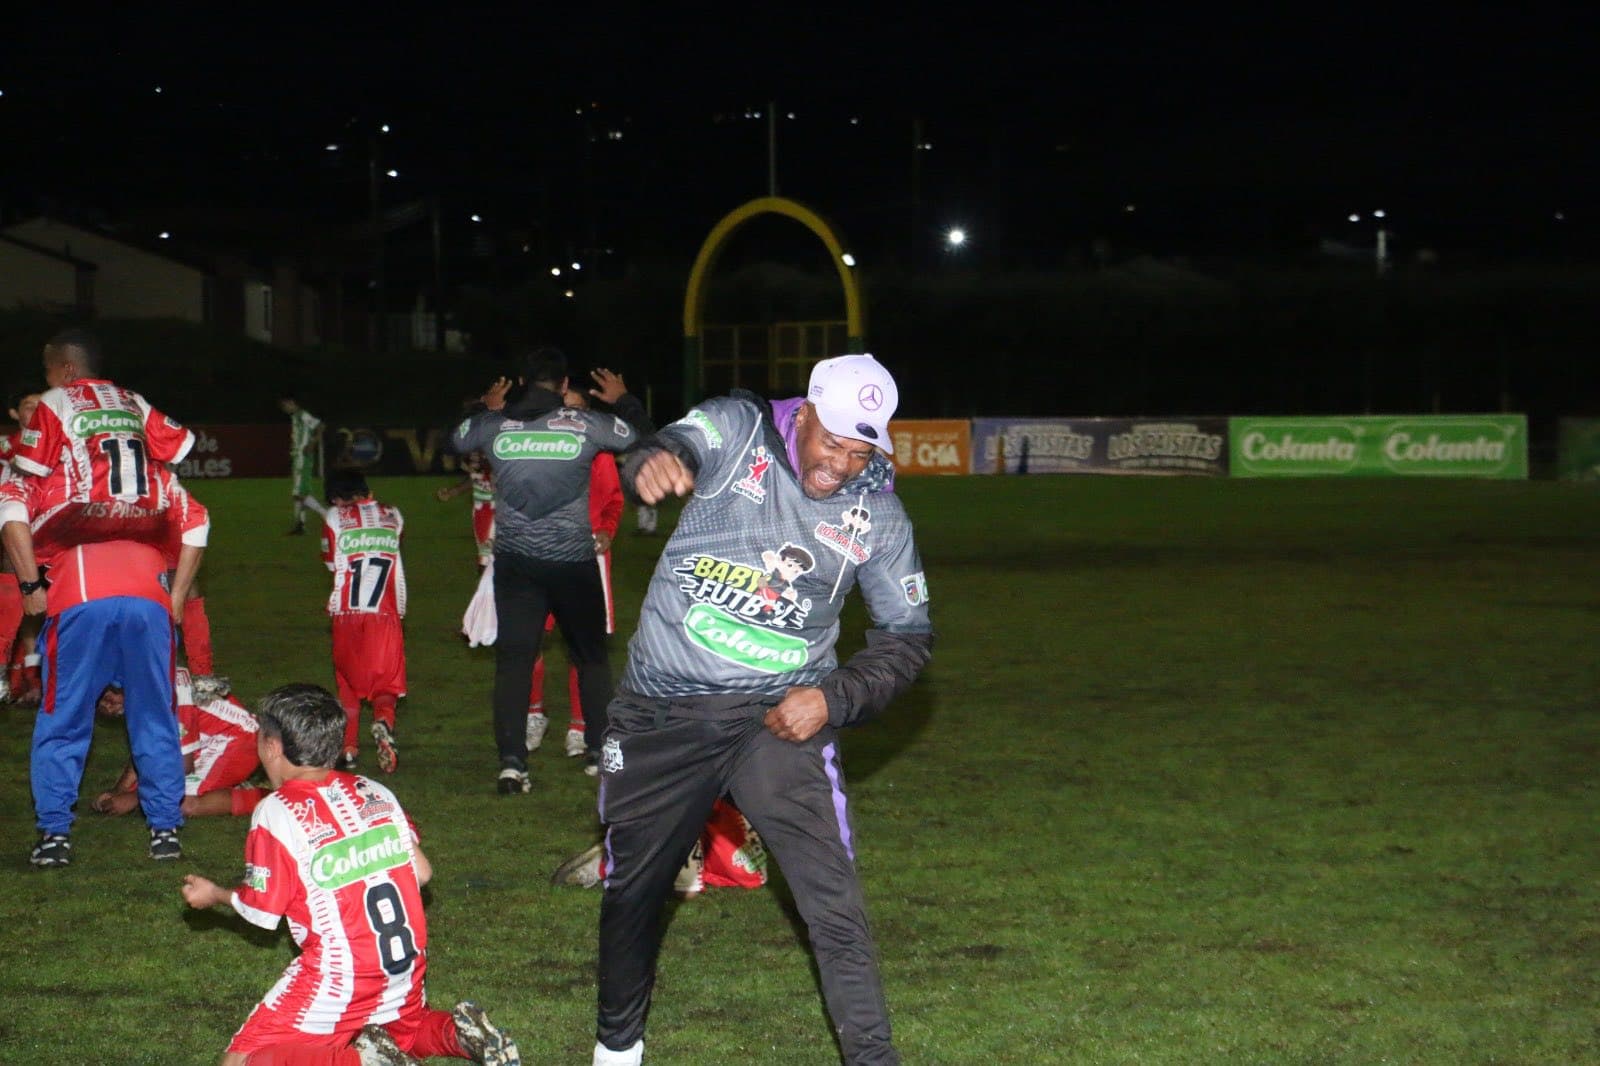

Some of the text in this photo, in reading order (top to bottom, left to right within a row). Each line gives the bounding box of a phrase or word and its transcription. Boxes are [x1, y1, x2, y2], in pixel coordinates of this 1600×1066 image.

[495, 435, 578, 455] Colanta
[1242, 431, 1355, 461] Colanta
[1386, 431, 1506, 461] Colanta
[101, 438, 149, 497] 11
[351, 557, 393, 609] 17
[693, 556, 771, 593] BABY
[313, 836, 407, 882] Colanta
[366, 880, 417, 976] 8
